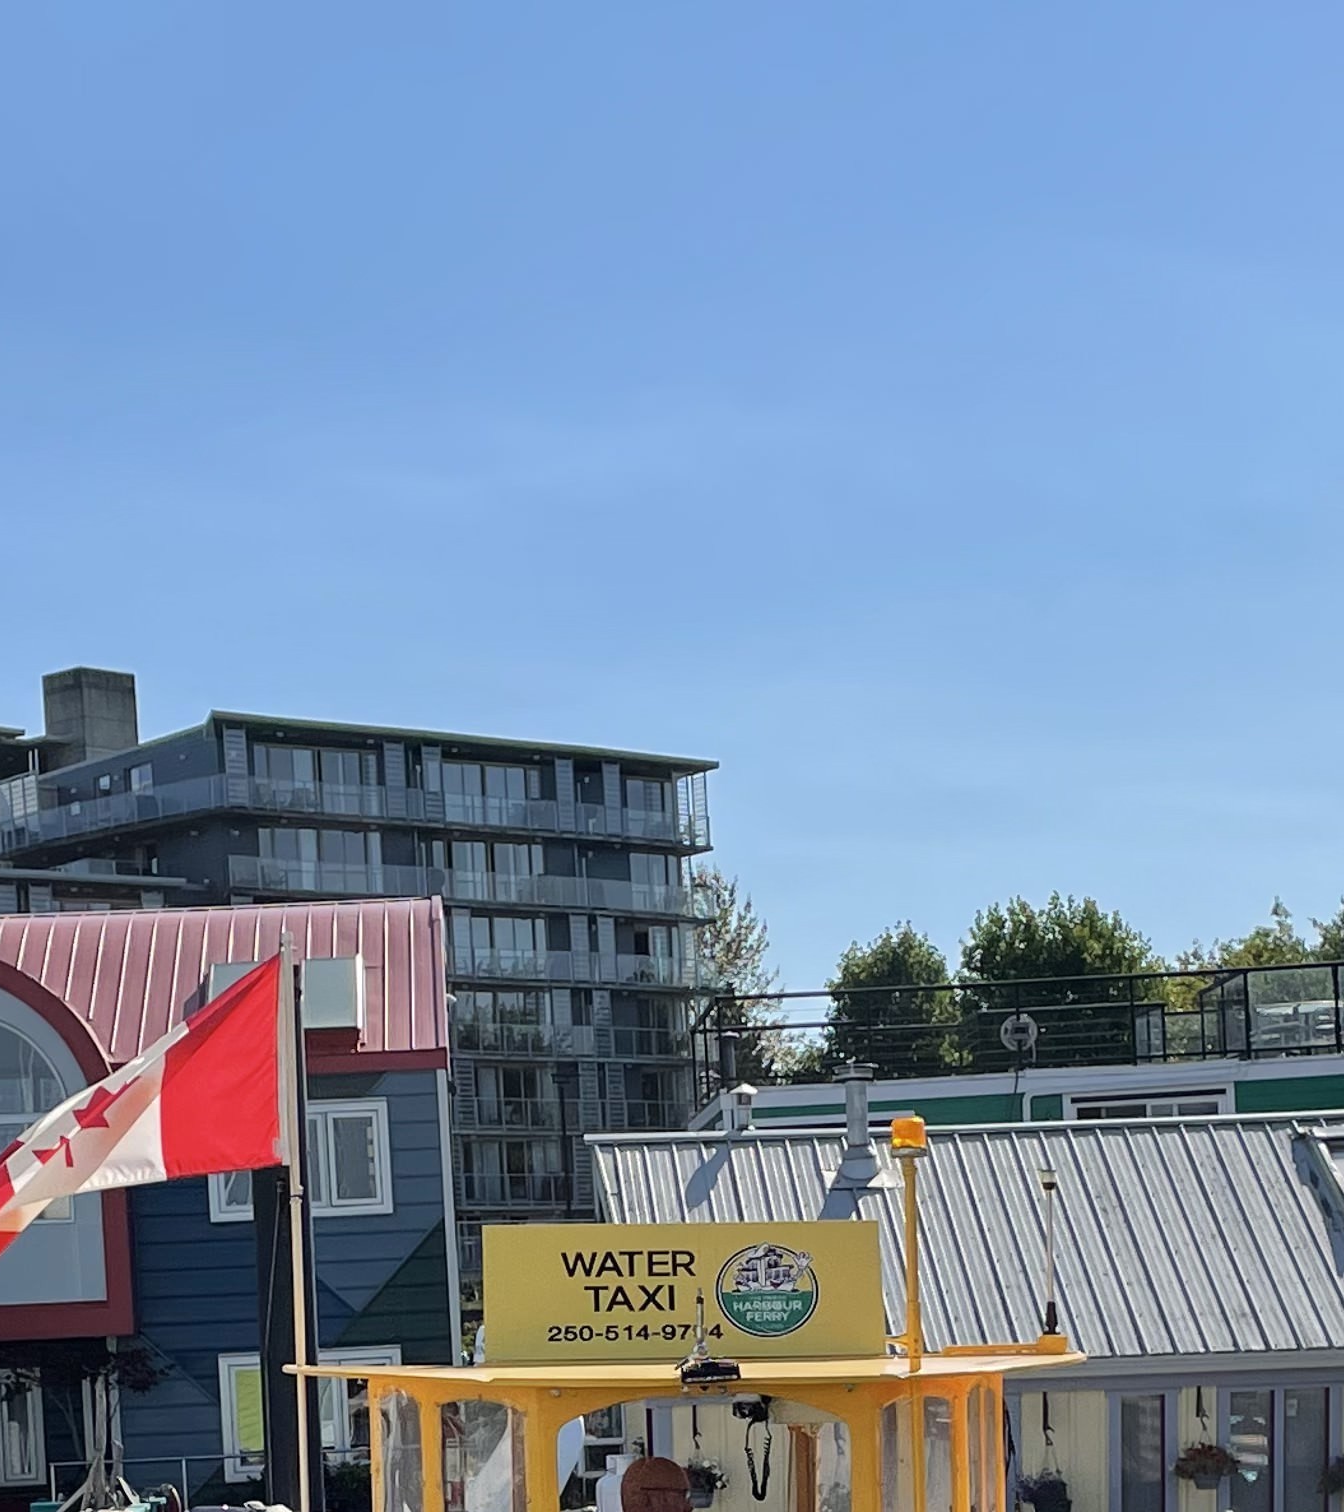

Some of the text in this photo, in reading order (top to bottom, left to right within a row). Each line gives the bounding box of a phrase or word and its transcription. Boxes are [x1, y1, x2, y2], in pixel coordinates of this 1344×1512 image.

[560, 1250, 697, 1278] WATER
[583, 1284, 676, 1313] TAXI
[732, 1300, 803, 1311] HARBOUR
[746, 1311, 791, 1322] FERRY
